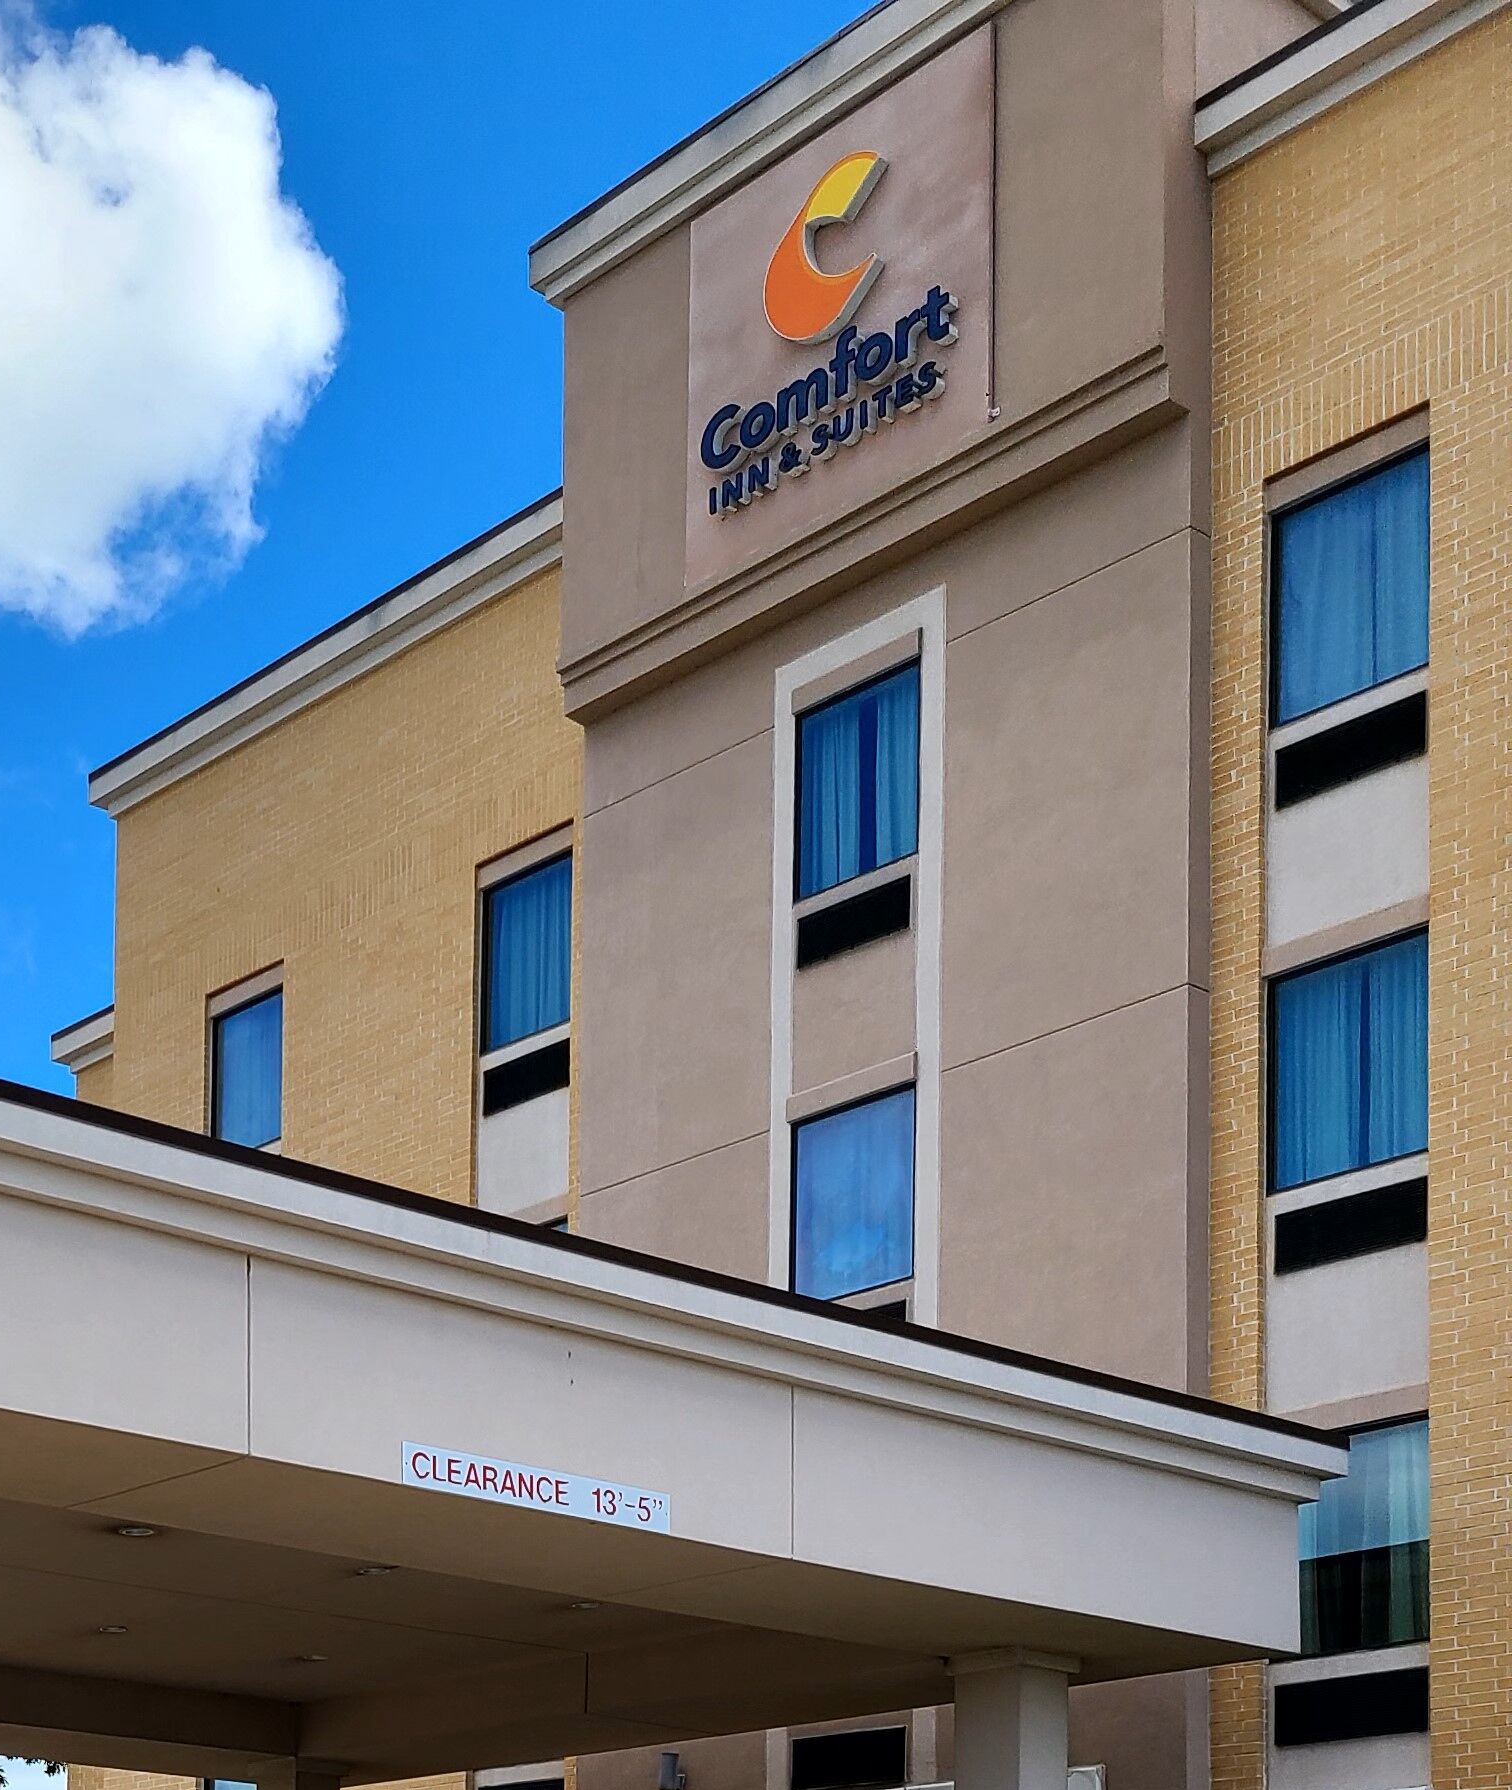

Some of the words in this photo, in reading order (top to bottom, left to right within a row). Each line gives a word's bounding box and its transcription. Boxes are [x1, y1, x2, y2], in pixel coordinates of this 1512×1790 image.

[700, 284, 955, 471] Comfort
[708, 456, 773, 518] INN
[778, 441, 807, 475] &
[811, 361, 941, 458] SUITES
[411, 1451, 570, 1506] CLEARANCE
